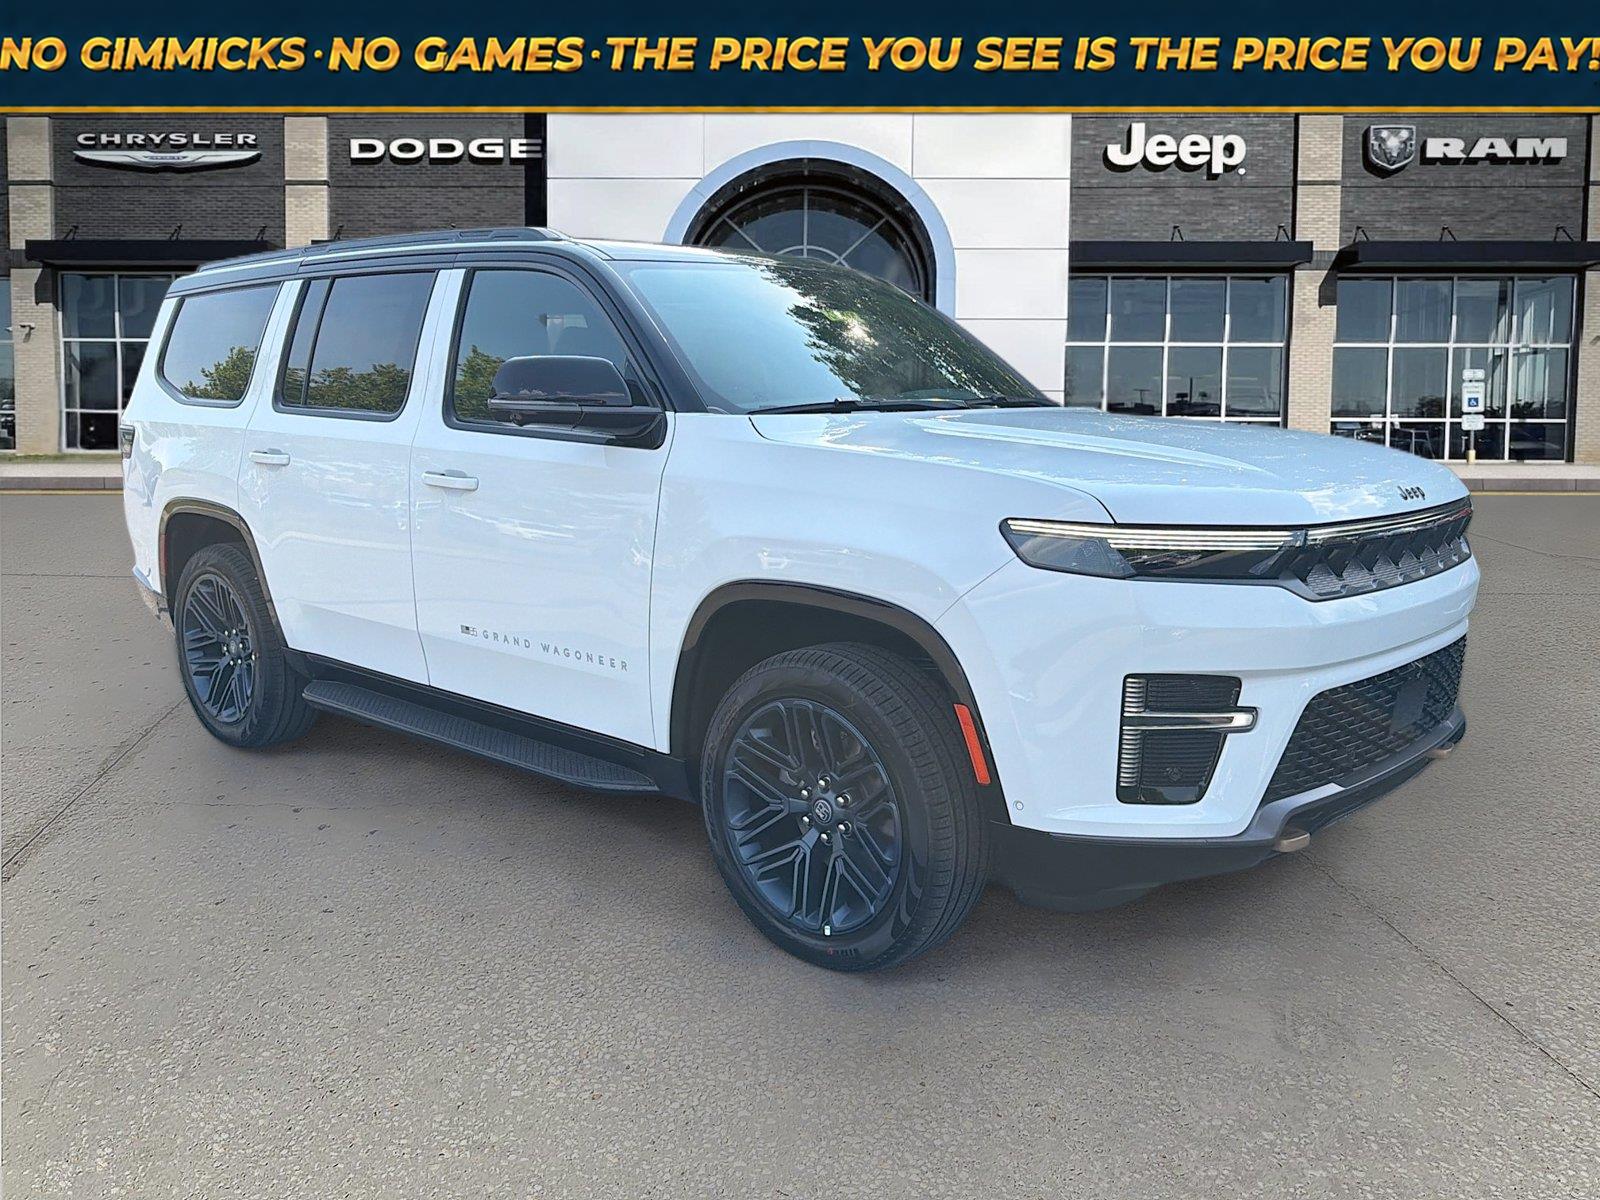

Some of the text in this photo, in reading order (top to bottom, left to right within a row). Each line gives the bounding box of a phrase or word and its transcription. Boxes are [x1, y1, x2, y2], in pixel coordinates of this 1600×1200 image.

[76, 133, 257, 146] CHRYSLER
[350, 137, 543, 159] DODGE
[1106, 122, 1247, 174] Jeep
[1425, 137, 1567, 158] RAM
[1397, 485, 1426, 501] Jeep
[482, 629, 628, 672] GRAND WAGONEER
